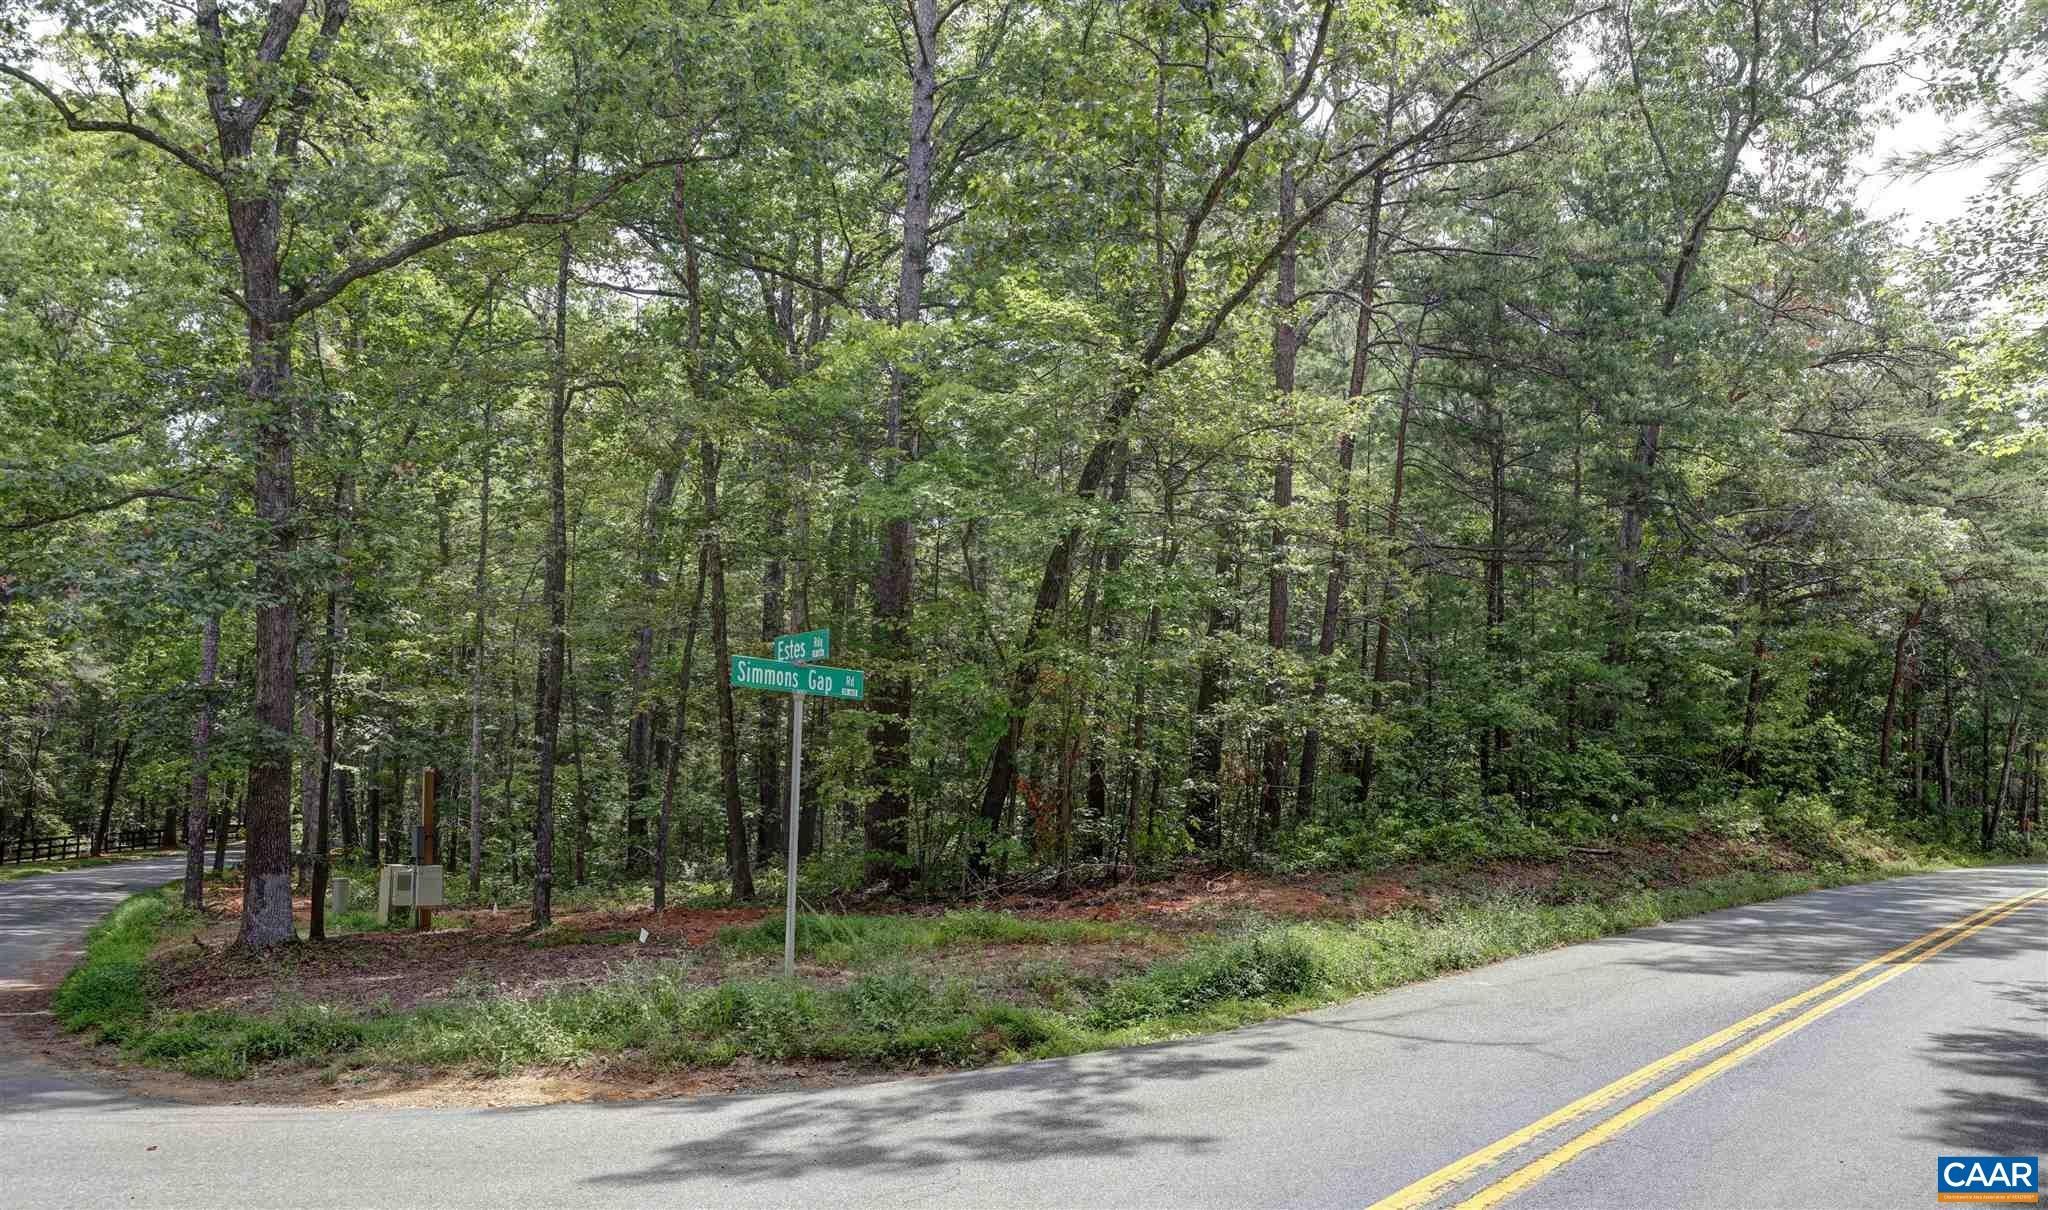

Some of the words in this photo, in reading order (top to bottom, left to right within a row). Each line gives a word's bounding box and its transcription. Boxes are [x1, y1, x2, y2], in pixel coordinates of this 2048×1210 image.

[778, 640, 806, 661] Estes
[737, 660, 799, 689] Simmons
[808, 669, 832, 695] Gap
[846, 675, 855, 689] Rd
